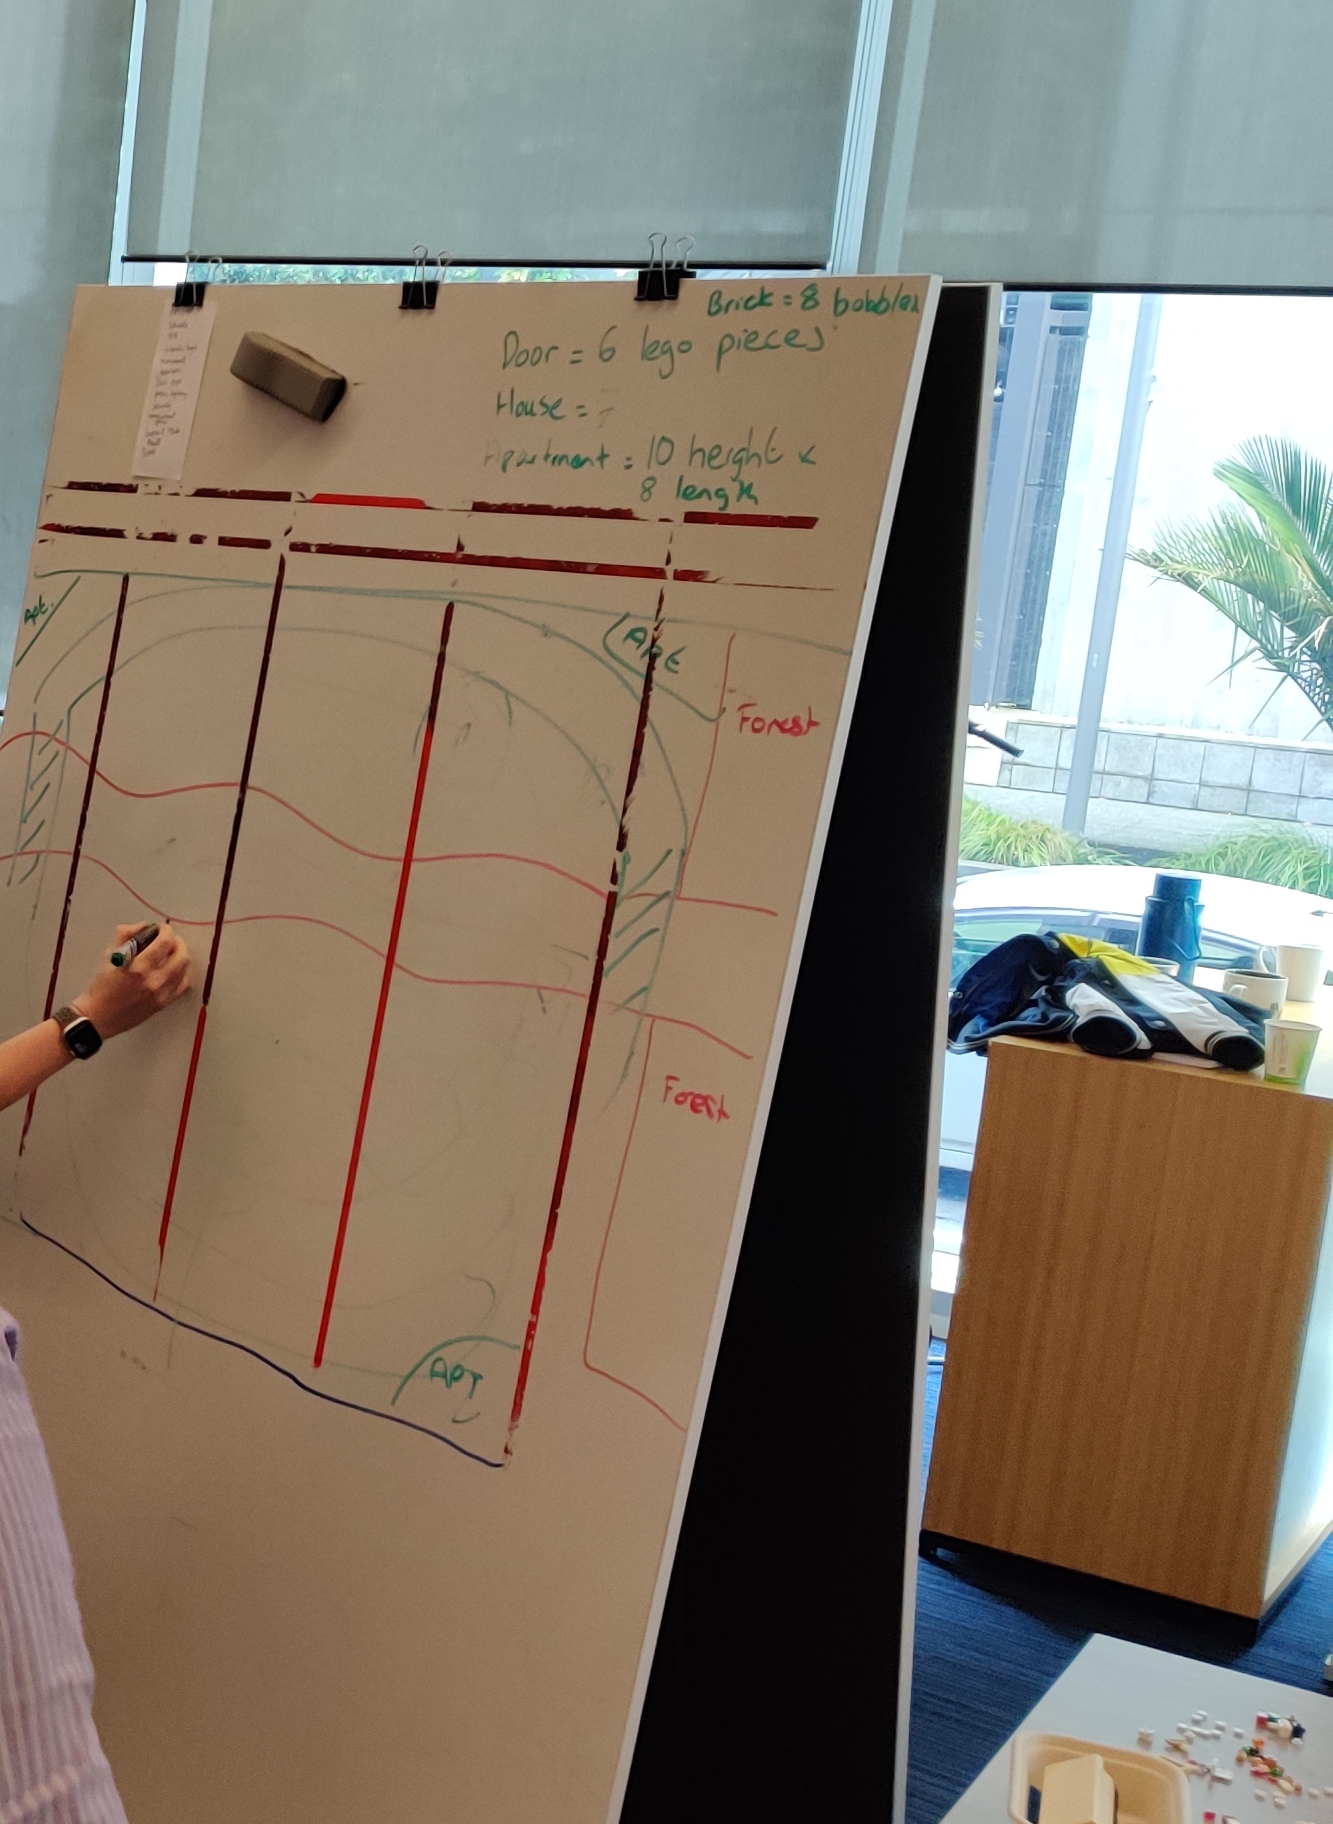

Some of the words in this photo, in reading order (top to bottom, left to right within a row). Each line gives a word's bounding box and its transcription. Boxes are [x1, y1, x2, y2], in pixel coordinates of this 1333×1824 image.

[707, 286, 773, 316] Brick
[800, 283, 820, 311] 8
[502, 330, 559, 370] Door
[598, 325, 618, 363] 6
[641, 324, 693, 379] lego
[716, 326, 825, 372] pieces
[496, 387, 566, 420] House
[647, 434, 674, 469] 10
[689, 426, 784, 481] height
[640, 475, 657, 502] 8
[737, 702, 821, 737] Forest
[663, 1074, 731, 1124] Forest
